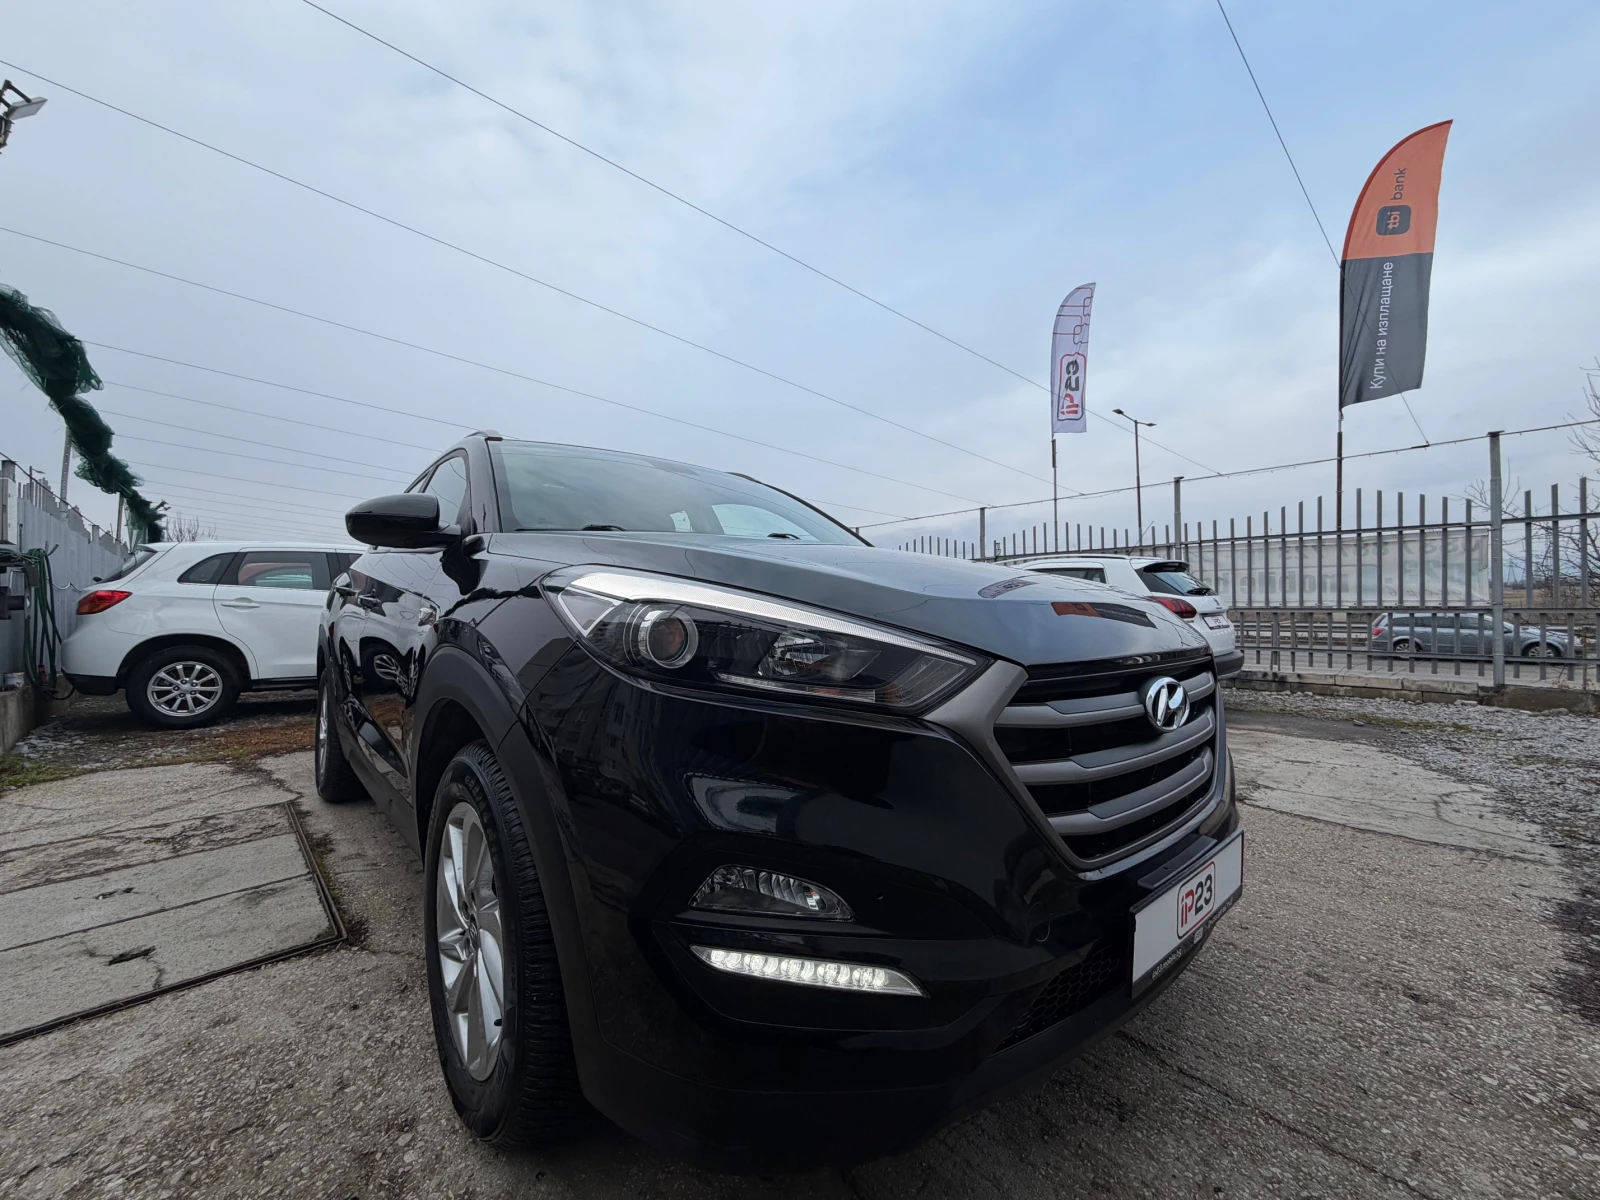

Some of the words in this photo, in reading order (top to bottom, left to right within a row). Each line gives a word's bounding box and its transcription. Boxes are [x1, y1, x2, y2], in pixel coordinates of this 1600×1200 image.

[1390, 167, 1407, 201] bank
[1387, 211, 1401, 230] tbi
[1378, 261, 1394, 336] изплащане
[1376, 339, 1387, 355] на
[1370, 358, 1387, 389] Купи
